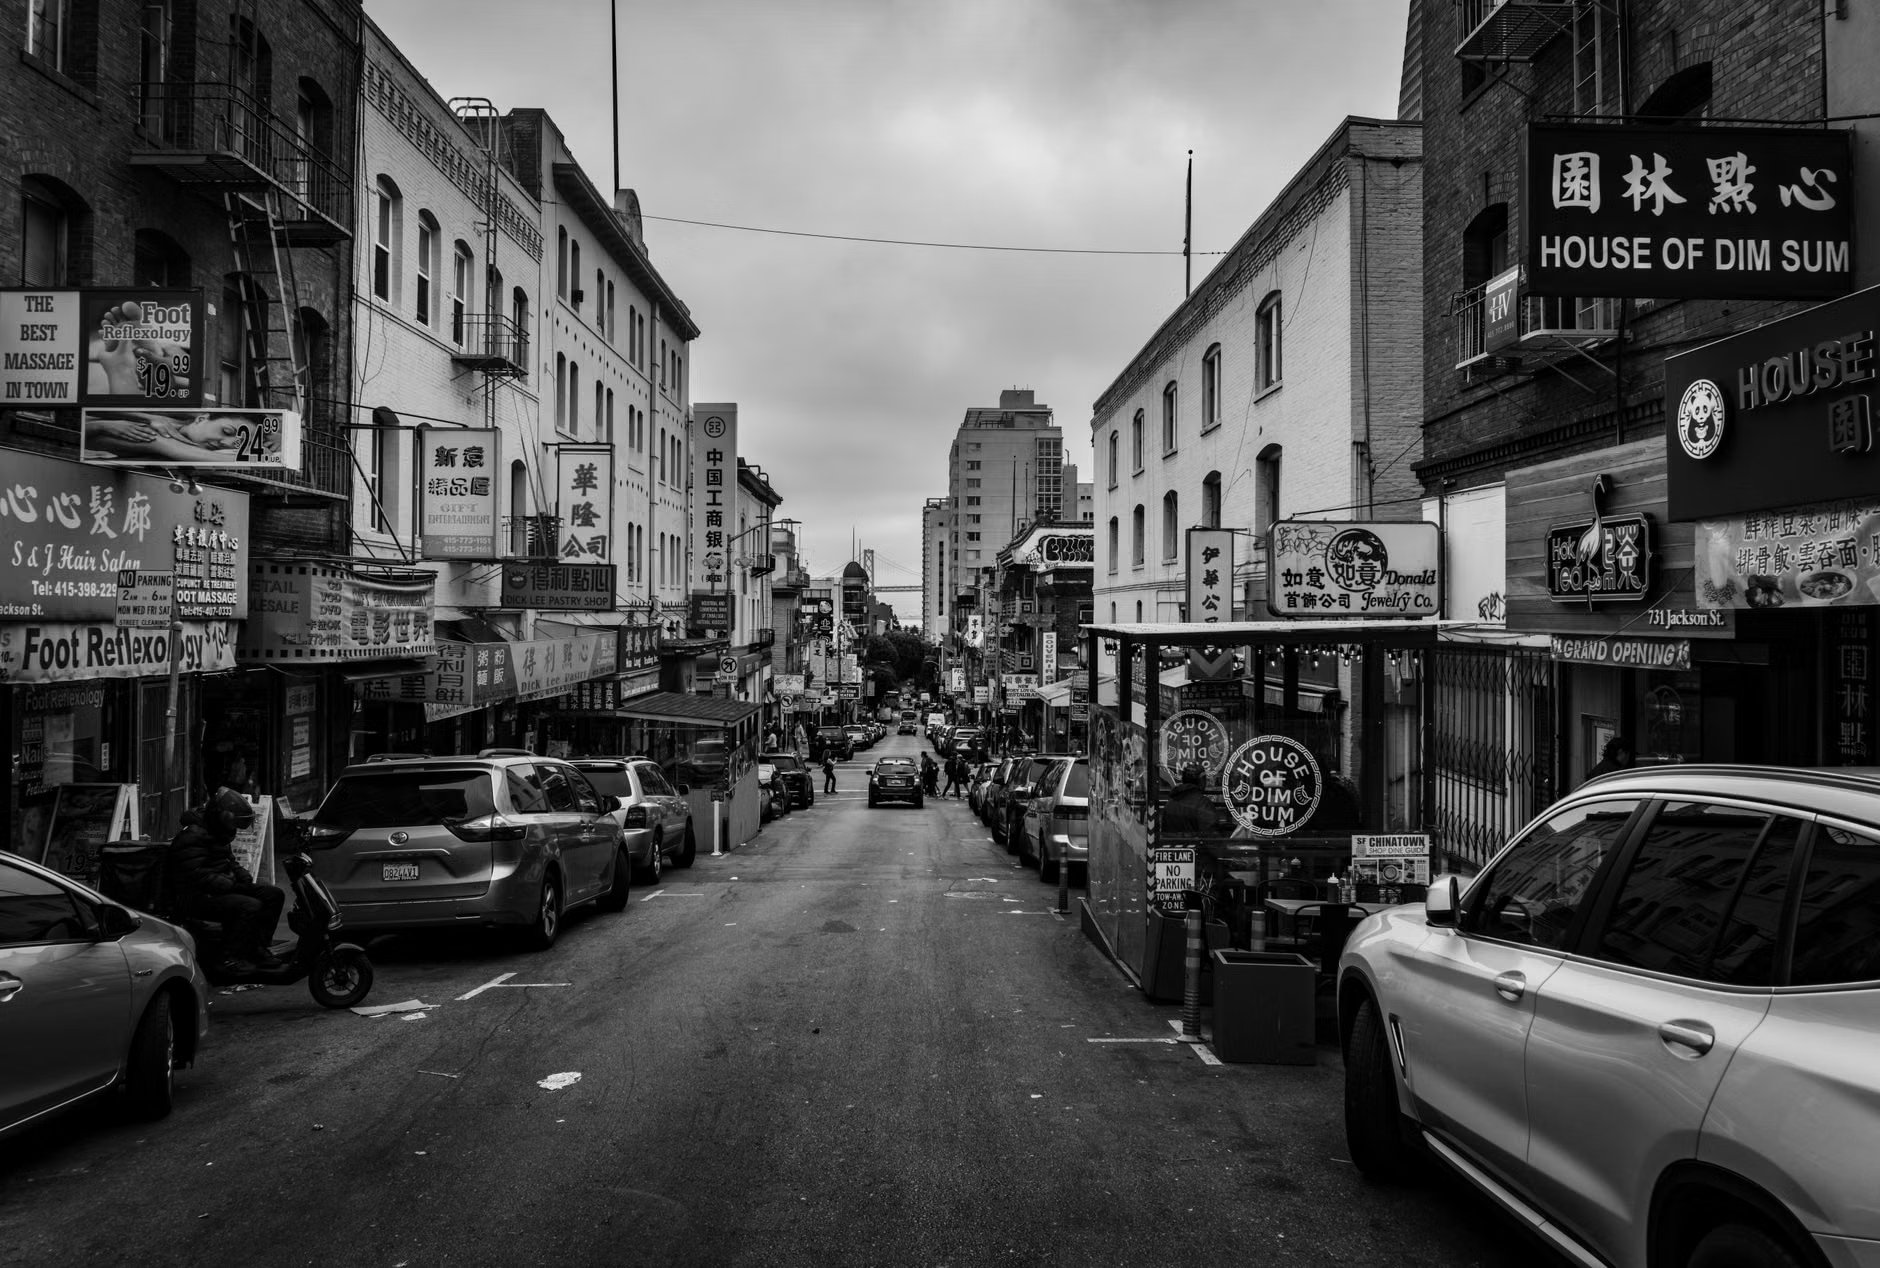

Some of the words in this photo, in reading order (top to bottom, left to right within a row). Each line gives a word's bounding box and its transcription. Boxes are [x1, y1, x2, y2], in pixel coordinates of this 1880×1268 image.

[1540, 235, 1652, 269] HOUSE
[1662, 237, 1705, 270] OF
[1715, 238, 1771, 271] DIM
[1781, 239, 1850, 272] SUM
[24, 296, 53, 313] THE
[140, 301, 191, 325] Foot
[20, 324, 58, 341] BEST
[102, 325, 192, 342] Reflexology
[4, 353, 74, 370] MASSAGE
[1738, 331, 1875, 411] HOUSE
[6, 382, 21, 399] IN
[24, 382, 69, 399] TOWN
[0, 484, 152, 542] 心心髮廊
[440, 502, 479, 513] GIFT
[560, 462, 607, 559] 華隆公司
[427, 514, 490, 525] ENTERTAINMENT
[1552, 535, 1576, 561] Hok
[12, 541, 23, 567] S
[27, 547, 39, 568] &
[42, 544, 54, 576] J
[57, 544, 96, 573] Hair
[99, 548, 141, 573] Salon
[119, 571, 134, 587] NO
[137, 575, 172, 587] PARKING
[530, 566, 610, 592] 得利點心
[1281, 566, 1326, 590] 如意
[1385, 569, 1437, 586] Donald
[1552, 562, 1583, 593] Tea
[32, 580, 52, 596] Tel:
[54, 581, 117, 597] 415-398-229
[249, 580, 299, 594] ETAIL
[327, 581, 343, 592] CD
[176, 590, 197, 603] OOT
[198, 591, 238, 604] MASSAGE
[320, 592, 343, 603] VCD
[506, 595, 527, 605] DICK
[529, 595, 546, 605] LEE
[548, 596, 581, 606] PASTRY
[584, 596, 609, 607] SHOP
[1284, 591, 1351, 610] 首飾公司
[1361, 591, 1411, 611] Jewelry
[1414, 593, 1433, 608] Co.
[32, 604, 45, 616] St.
[118, 605, 131, 615] MON
[132, 605, 146, 615] WED
[147, 606, 157, 615] FRI
[158, 606, 170, 615] SAT
[249, 600, 299, 614] LESALE
[320, 604, 343, 616] DVD
[350, 610, 429, 645] 電影世界
[1649, 609, 1665, 625] 731
[1665, 609, 1708, 629] Jackson
[1709, 609, 1725, 626] St.
[22, 628, 80, 670] Foot
[87, 627, 203, 669] Reflexolgy
[1563, 639, 1608, 660] GRAND
[435, 643, 467, 702] 得利月餅
[520, 679, 541, 693] Dick
[546, 676, 561, 688] Lee
[25, 691, 49, 712] Foot
[50, 688, 105, 709] Reflexology
[1237, 746, 1310, 781] HOUSE
[1260, 770, 1287, 785] OF
[1252, 786, 1291, 804] DIM
[1246, 804, 1295, 823] SUM
[1357, 837, 1367, 845] SF
[1369, 837, 1425, 847] CHINATOWN
[1155, 851, 1172, 862] FIRE
[1174, 851, 1192, 862] LANE
[1166, 865, 1181, 877] NO
[1156, 878, 1192, 890] PARKING
[1156, 893, 1184, 901] TOW-AW
[1162, 902, 1185, 910] ZONE
